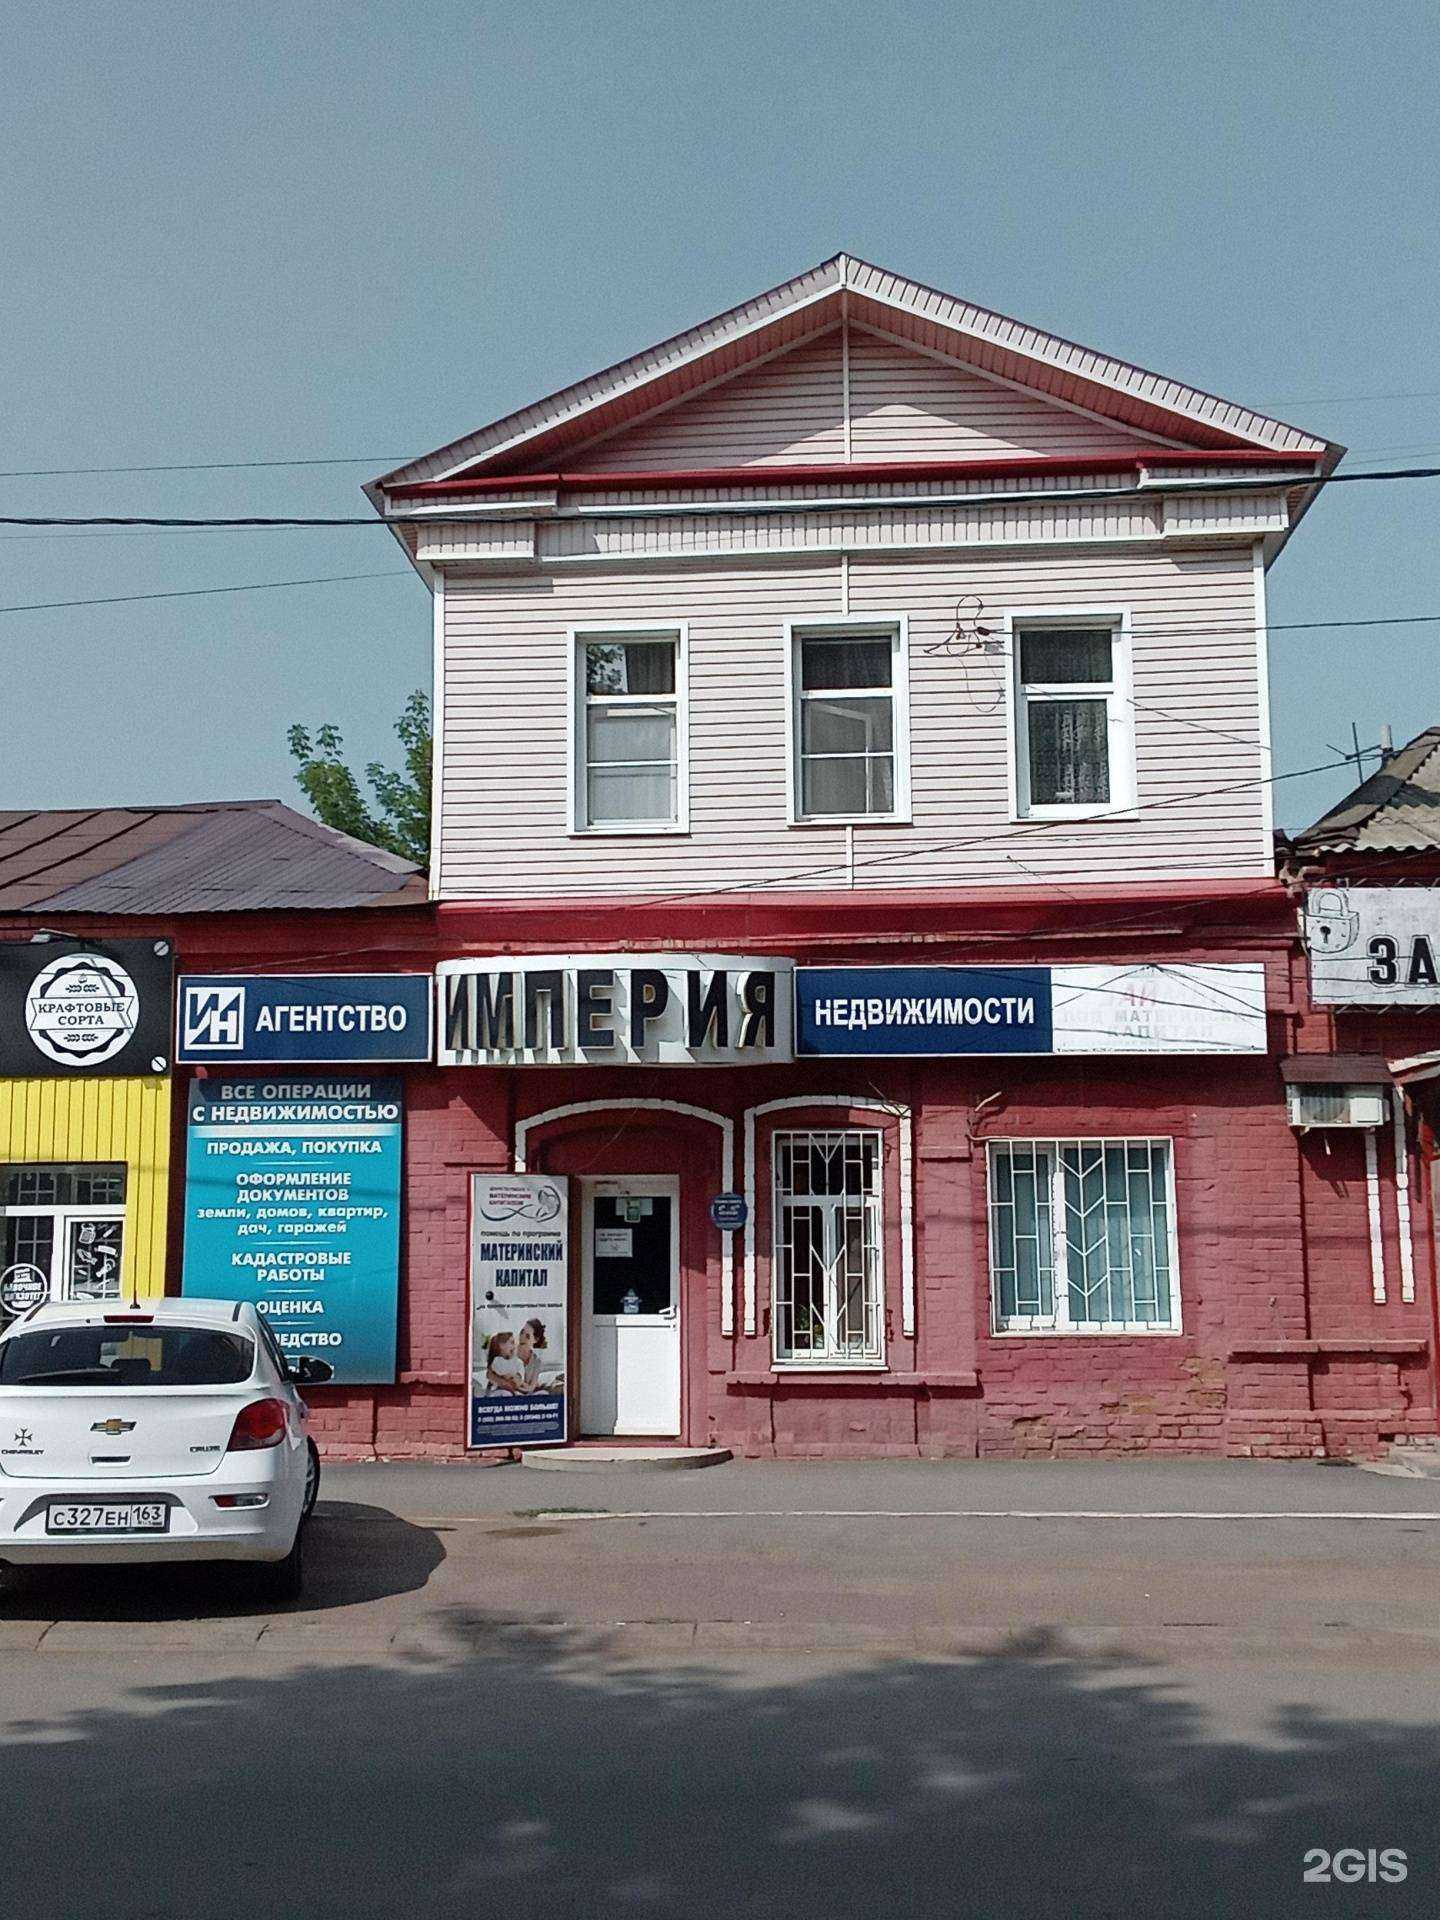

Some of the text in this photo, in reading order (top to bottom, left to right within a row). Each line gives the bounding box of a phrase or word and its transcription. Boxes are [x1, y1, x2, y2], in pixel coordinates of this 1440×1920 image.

[38, 1002, 125, 1013] КРАФТОВЫЕ
[445, 969, 775, 1050] ИМПЕРИЯ
[814, 997, 1035, 1030] НЕДВИЖИМОСТИ
[58, 1016, 104, 1026] СОРТА
[255, 1005, 407, 1032] АГЕНТСТВО
[221, 1084, 371, 1100] ВСЕ ОПЕРАЦИИ
[192, 1104, 399, 1123] С НЕДВИЖИМОСТЬЮ
[207, 1141, 382, 1155] ПРОДАЖА, ПОКУПКА
[236, 1173, 352, 1186] ОФОРМЛЕНИЕ
[237, 1189, 349, 1203] ДОКУМЕНТОВ
[197, 1207, 388, 1220] земли, домов, квартир,
[237, 1221, 347, 1236] дач, гаражей
[480, 1240, 563, 1261] МАТЕРИНСКИЙ
[232, 1252, 352, 1266] КАДАСТРОВЫЕ
[257, 1269, 325, 1281] РАБОТЫ
[495, 1269, 548, 1287] КАПИТАЛ
[256, 1301, 324, 1315] ОЦЕНКА
